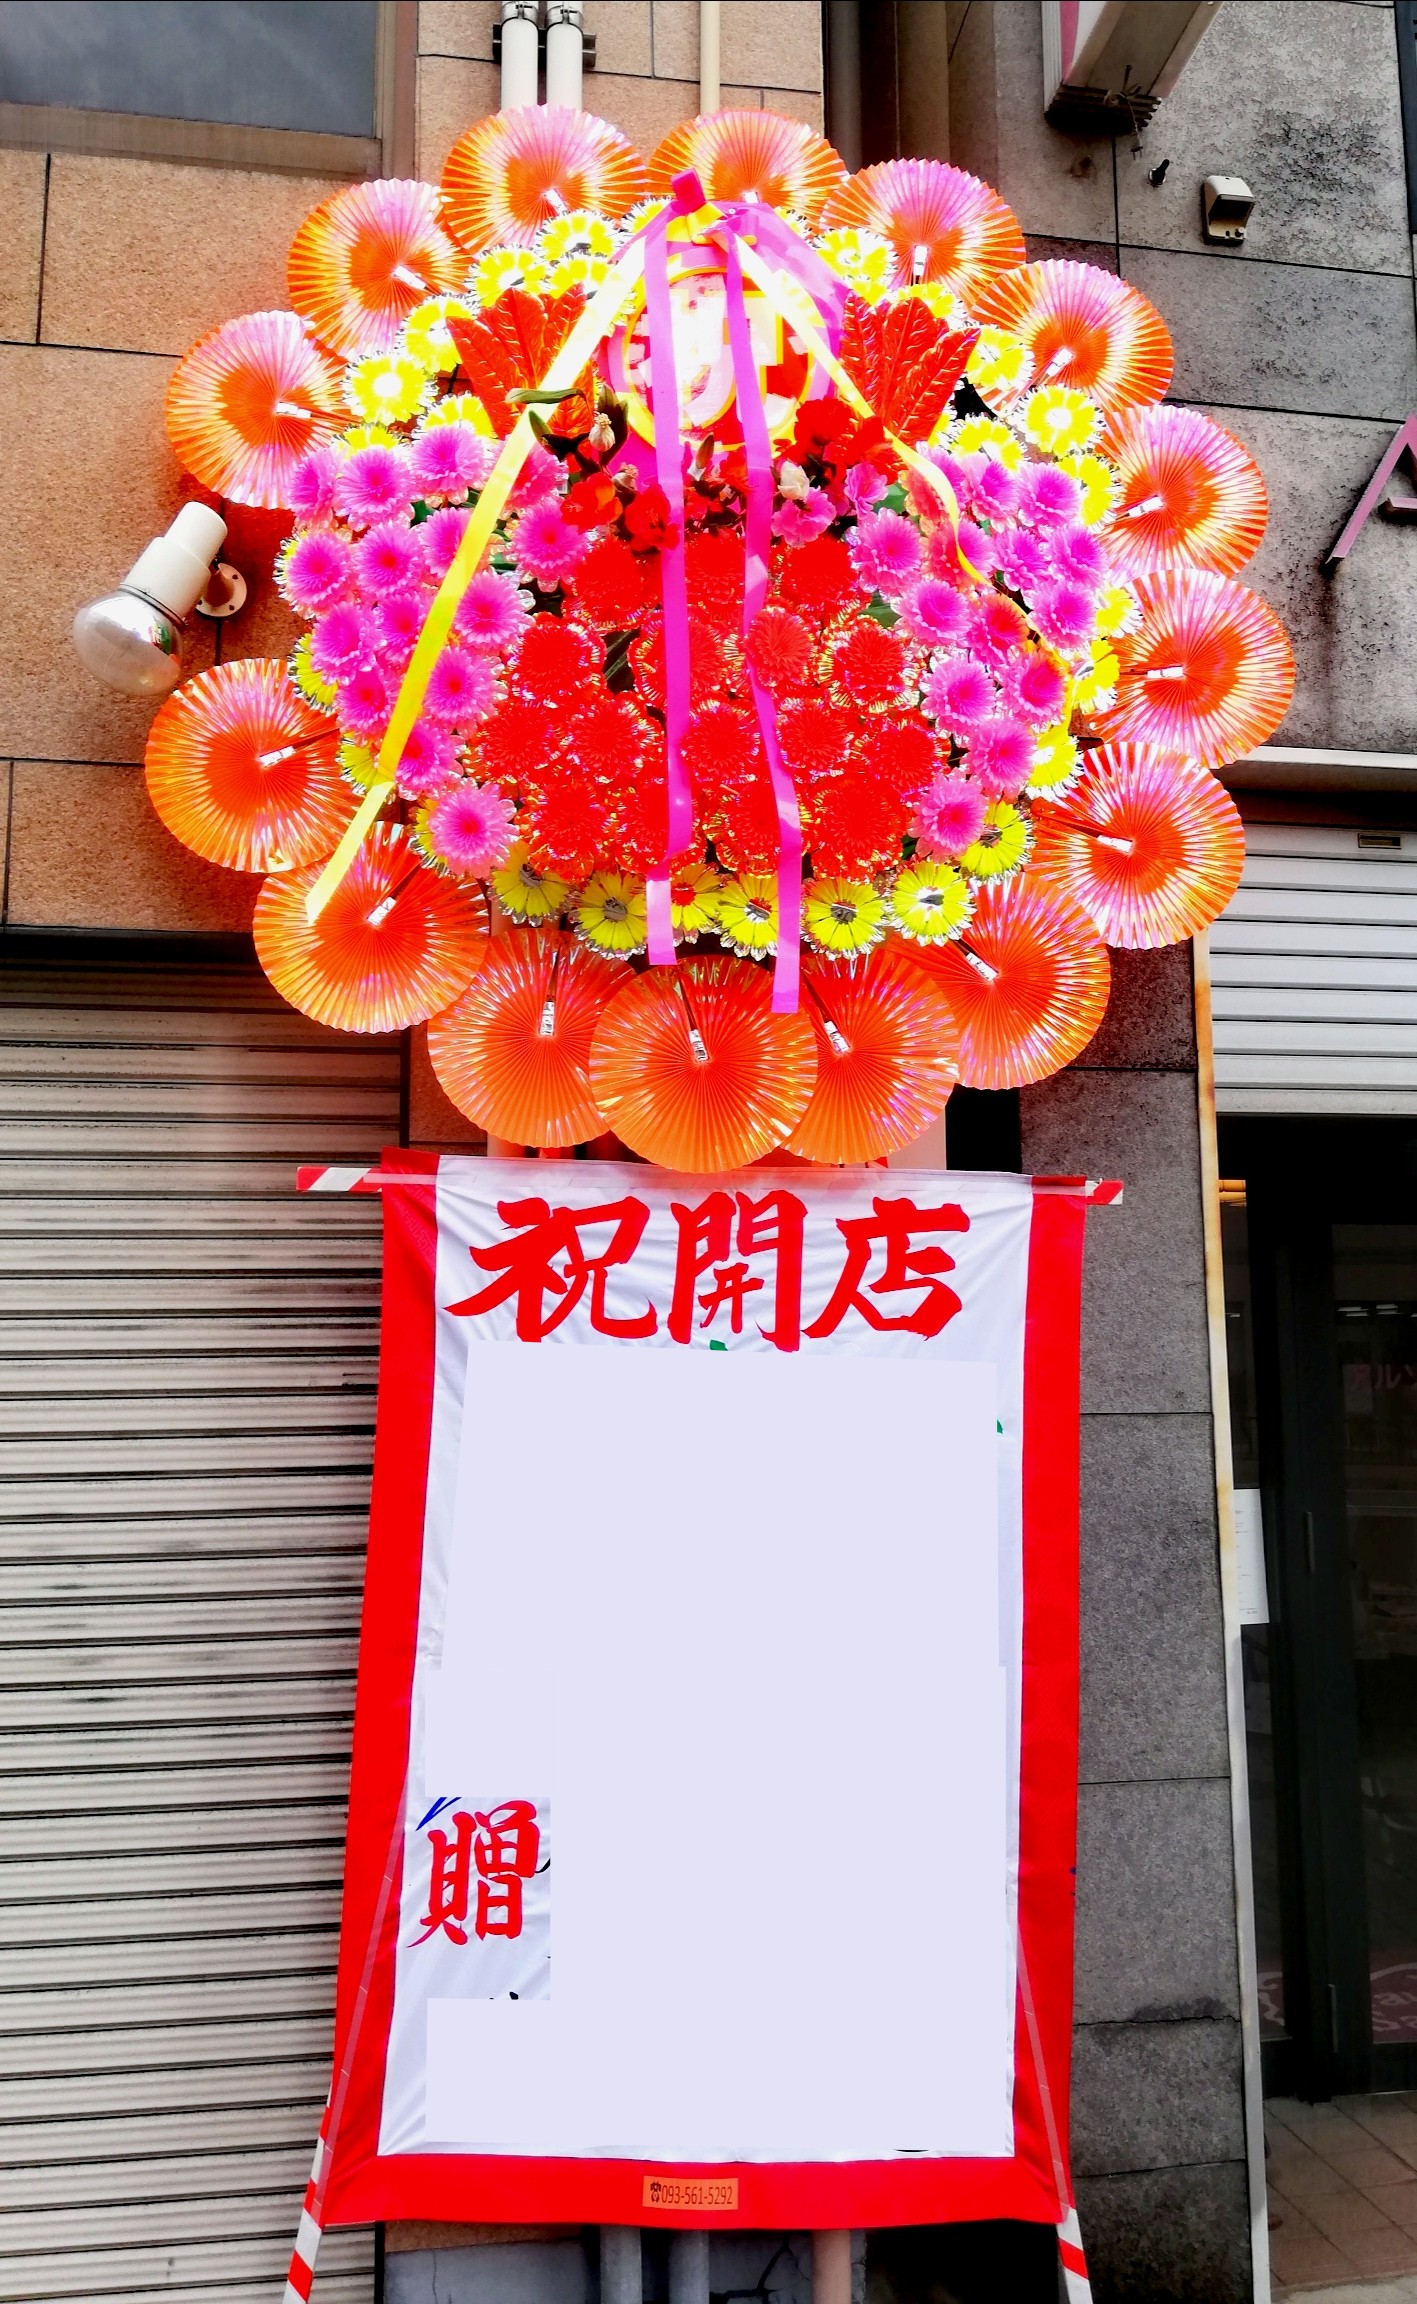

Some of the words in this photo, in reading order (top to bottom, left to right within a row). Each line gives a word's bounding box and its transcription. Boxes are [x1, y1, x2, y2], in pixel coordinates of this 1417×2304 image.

[443, 1189, 971, 1351] 祝開店
[406, 1800, 540, 1948] 贈
[661, 2185, 733, 2205] 093-561-5292
